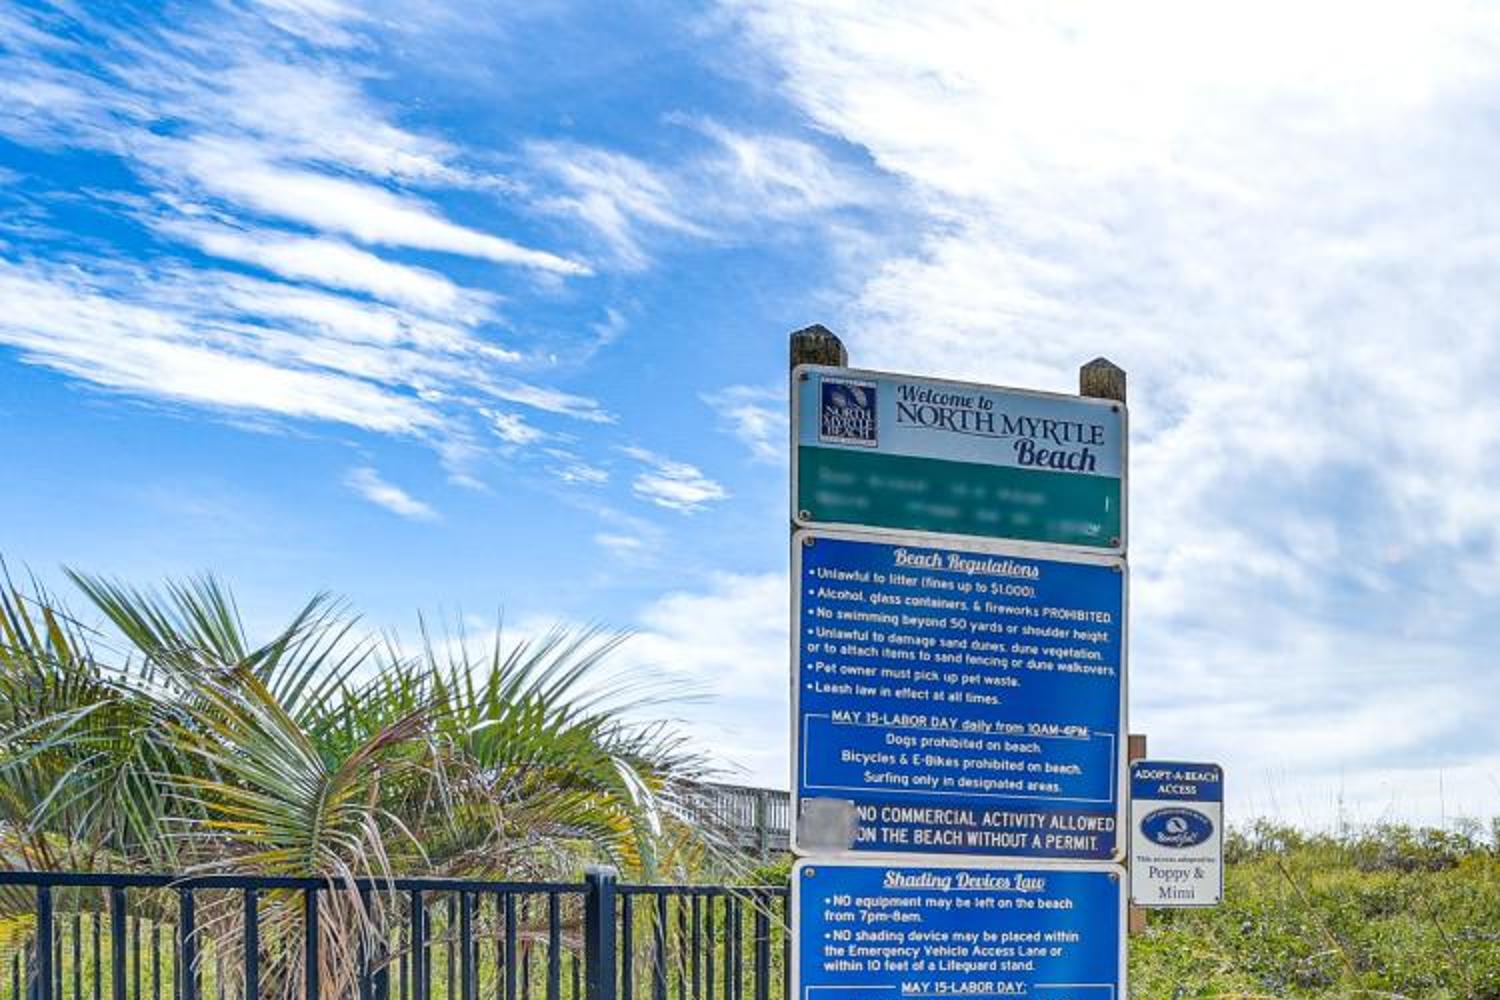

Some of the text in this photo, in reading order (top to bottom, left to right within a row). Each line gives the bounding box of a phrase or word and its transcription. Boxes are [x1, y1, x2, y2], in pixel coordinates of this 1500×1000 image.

[898, 385, 992, 410] Welcome to
[896, 401, 1104, 446] NORTH MYRTLE
[1014, 438, 1095, 470] Beach
[894, 548, 1039, 576] Beach Regulations
[817, 568, 987, 593] Unlawful to litter (fines up to
[870, 594, 900, 605] glass
[985, 601, 1040, 617] fireworks
[816, 608, 1069, 638] No swimming beyond 50 yards or shoulder
[816, 627, 1038, 654] Unlawful to damage sand dune
[808, 643, 1054, 670] or to attach items to sand fencing dune
[816, 662, 1020, 687] Pet owner must pick up pet waste.
[815, 682, 1001, 704] Leash law in effect all times.
[832, 710, 1024, 732] MAY 15-LABOR DAY daily from
[886, 733, 982, 749] Dogs prohibited
[842, 750, 1024, 770] Bicycles E-Bikes prohibited
[864, 771, 1022, 790] Surfing only designated
[1136, 770, 1219, 782] ADOPT-A-BEACH
[1158, 785, 1196, 794] ACCESS
[882, 808, 976, 825] COMMERCIAL
[982, 812, 1045, 828] ACTIVITY
[1050, 815, 1114, 831] ALLOWED
[882, 828, 1098, 850] THE BEACH WITHOUT A PERMIT.
[884, 870, 1046, 892] Shading Devices Law
[1149, 866, 1204, 882] Poppy &
[833, 895, 1072, 910] NO equipment may be left the beach
[1159, 888, 1194, 898] Mimi
[824, 911, 854, 921] from
[833, 930, 1079, 945] NO shading device may be placed within
[824, 945, 1047, 958] the Emergency Vehicle Access Lane
[824, 960, 996, 974] within 10 feet of Lifeguard
[902, 982, 992, 993] MAY 15-LABOR
